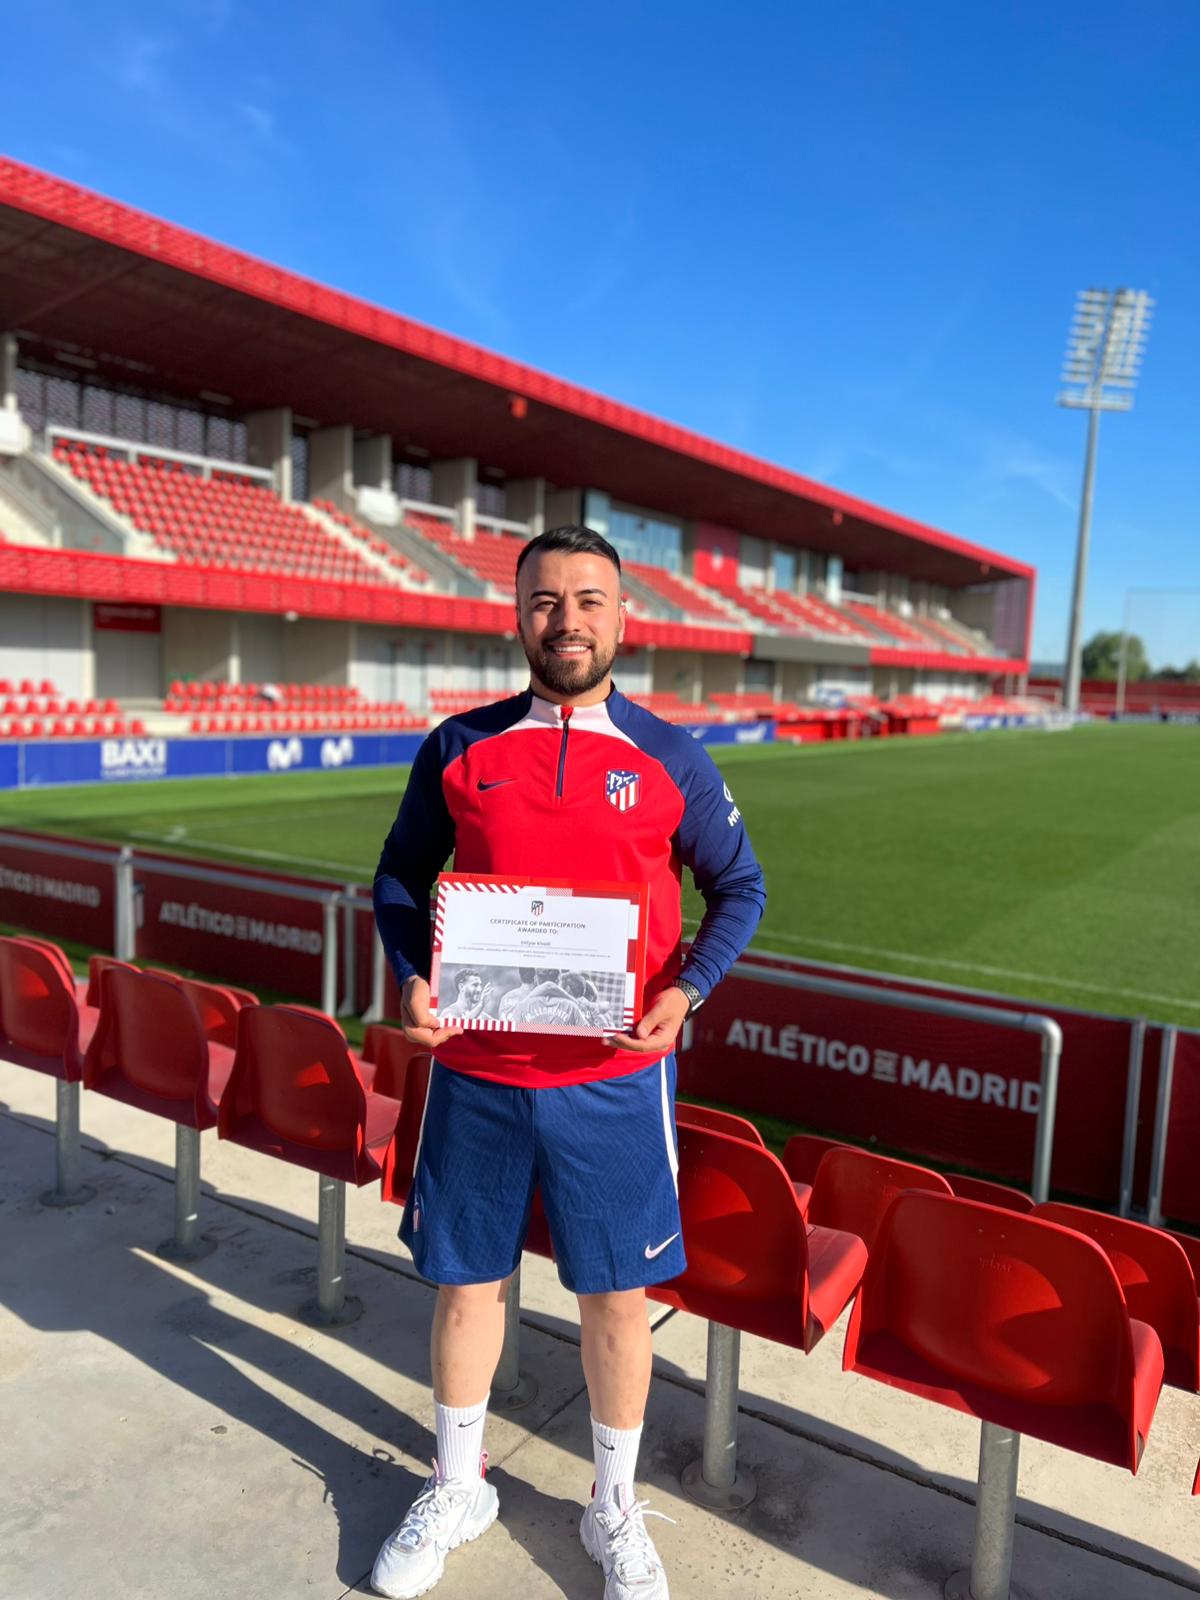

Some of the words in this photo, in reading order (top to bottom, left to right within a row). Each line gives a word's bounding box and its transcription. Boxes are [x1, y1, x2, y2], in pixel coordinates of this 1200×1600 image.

[101, 740, 166, 768] BAXI
[158, 901, 235, 937] ATLÉTICO
[249, 918, 322, 955] MADRID
[490, 918, 528, 926] CERTIFICATE
[539, 921, 586, 929] PARTICIPATION
[725, 1019, 869, 1075] ATLÉTICO
[873, 1054, 898, 1078] DE
[901, 1055, 1043, 1115] MADRID
